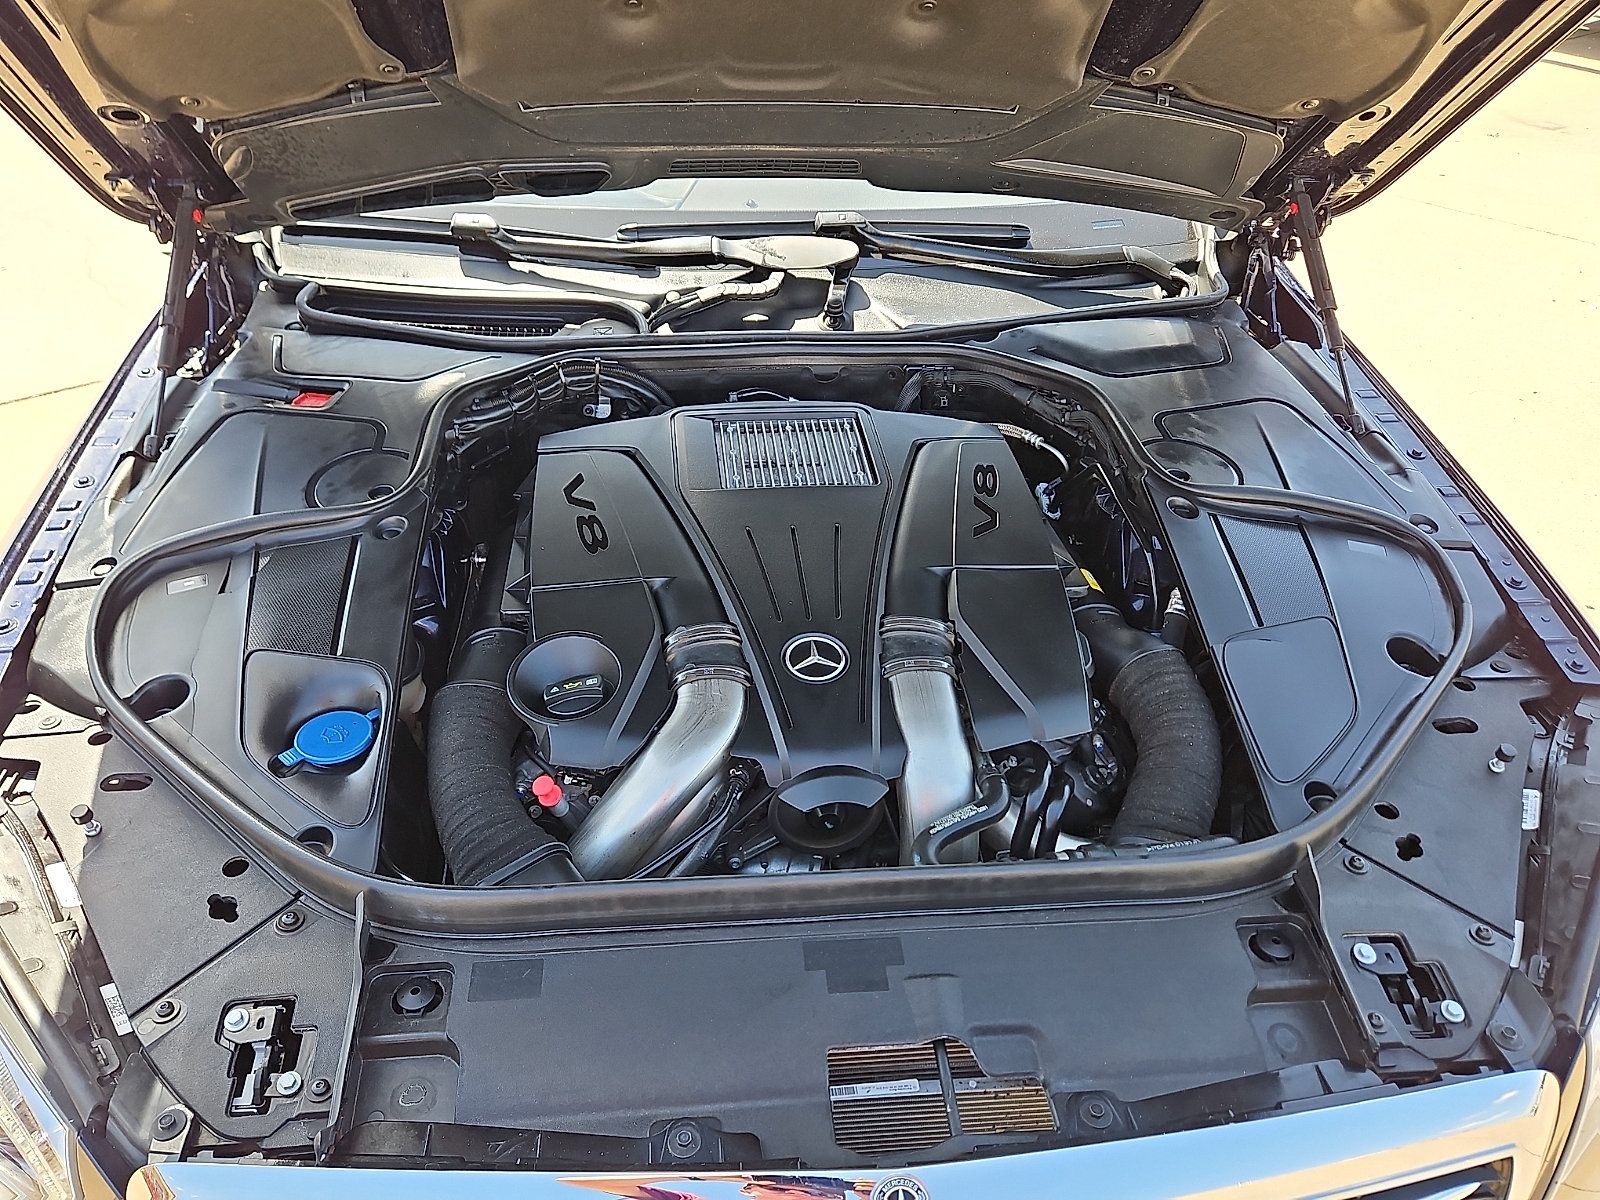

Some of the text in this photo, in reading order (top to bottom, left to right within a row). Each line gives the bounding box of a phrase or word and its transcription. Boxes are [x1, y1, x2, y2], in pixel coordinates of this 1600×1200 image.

[562, 472, 610, 555] V8
[972, 463, 999, 539] V8
[882, 1179, 919, 1192] MERCEDES
